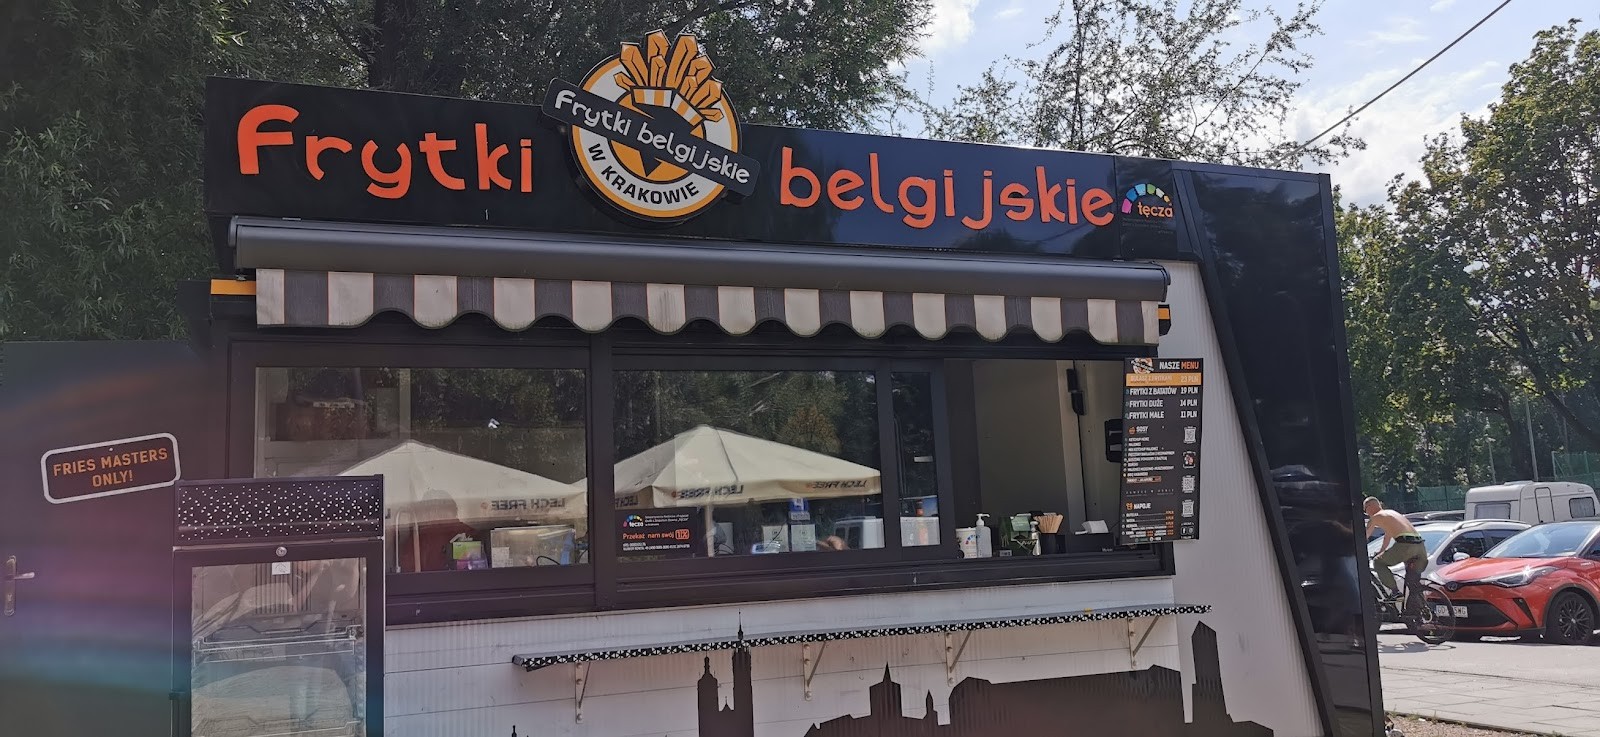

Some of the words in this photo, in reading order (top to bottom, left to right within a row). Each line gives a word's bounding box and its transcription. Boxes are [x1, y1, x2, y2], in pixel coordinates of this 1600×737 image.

[555, 89, 632, 136] Frytki
[637, 121, 750, 182] belgijskie
[237, 104, 532, 199] Frytki
[780, 147, 1115, 229] belgijskie
[588, 143, 606, 162] W
[601, 165, 699, 204] KRAKOWIE
[1137, 201, 1173, 218] tęcza
[1159, 361, 1180, 370] NASZE
[1181, 361, 1199, 370] MENU
[1188, 375, 1198, 383] PLN
[1130, 387, 1148, 395] FRYTKI
[1149, 387, 1152, 395] Z
[1153, 386, 1177, 395] BATATÓW
[1130, 400, 1148, 408] FRYTKI
[1180, 399, 1186, 407] 14
[1187, 399, 1197, 407] PLN
[1129, 411, 1148, 419] FRYTKI
[1187, 410, 1197, 418] PLN
[53, 459, 96, 476] FRIES
[101, 448, 168, 469] MASTERS
[92, 470, 133, 487] ONLY!
